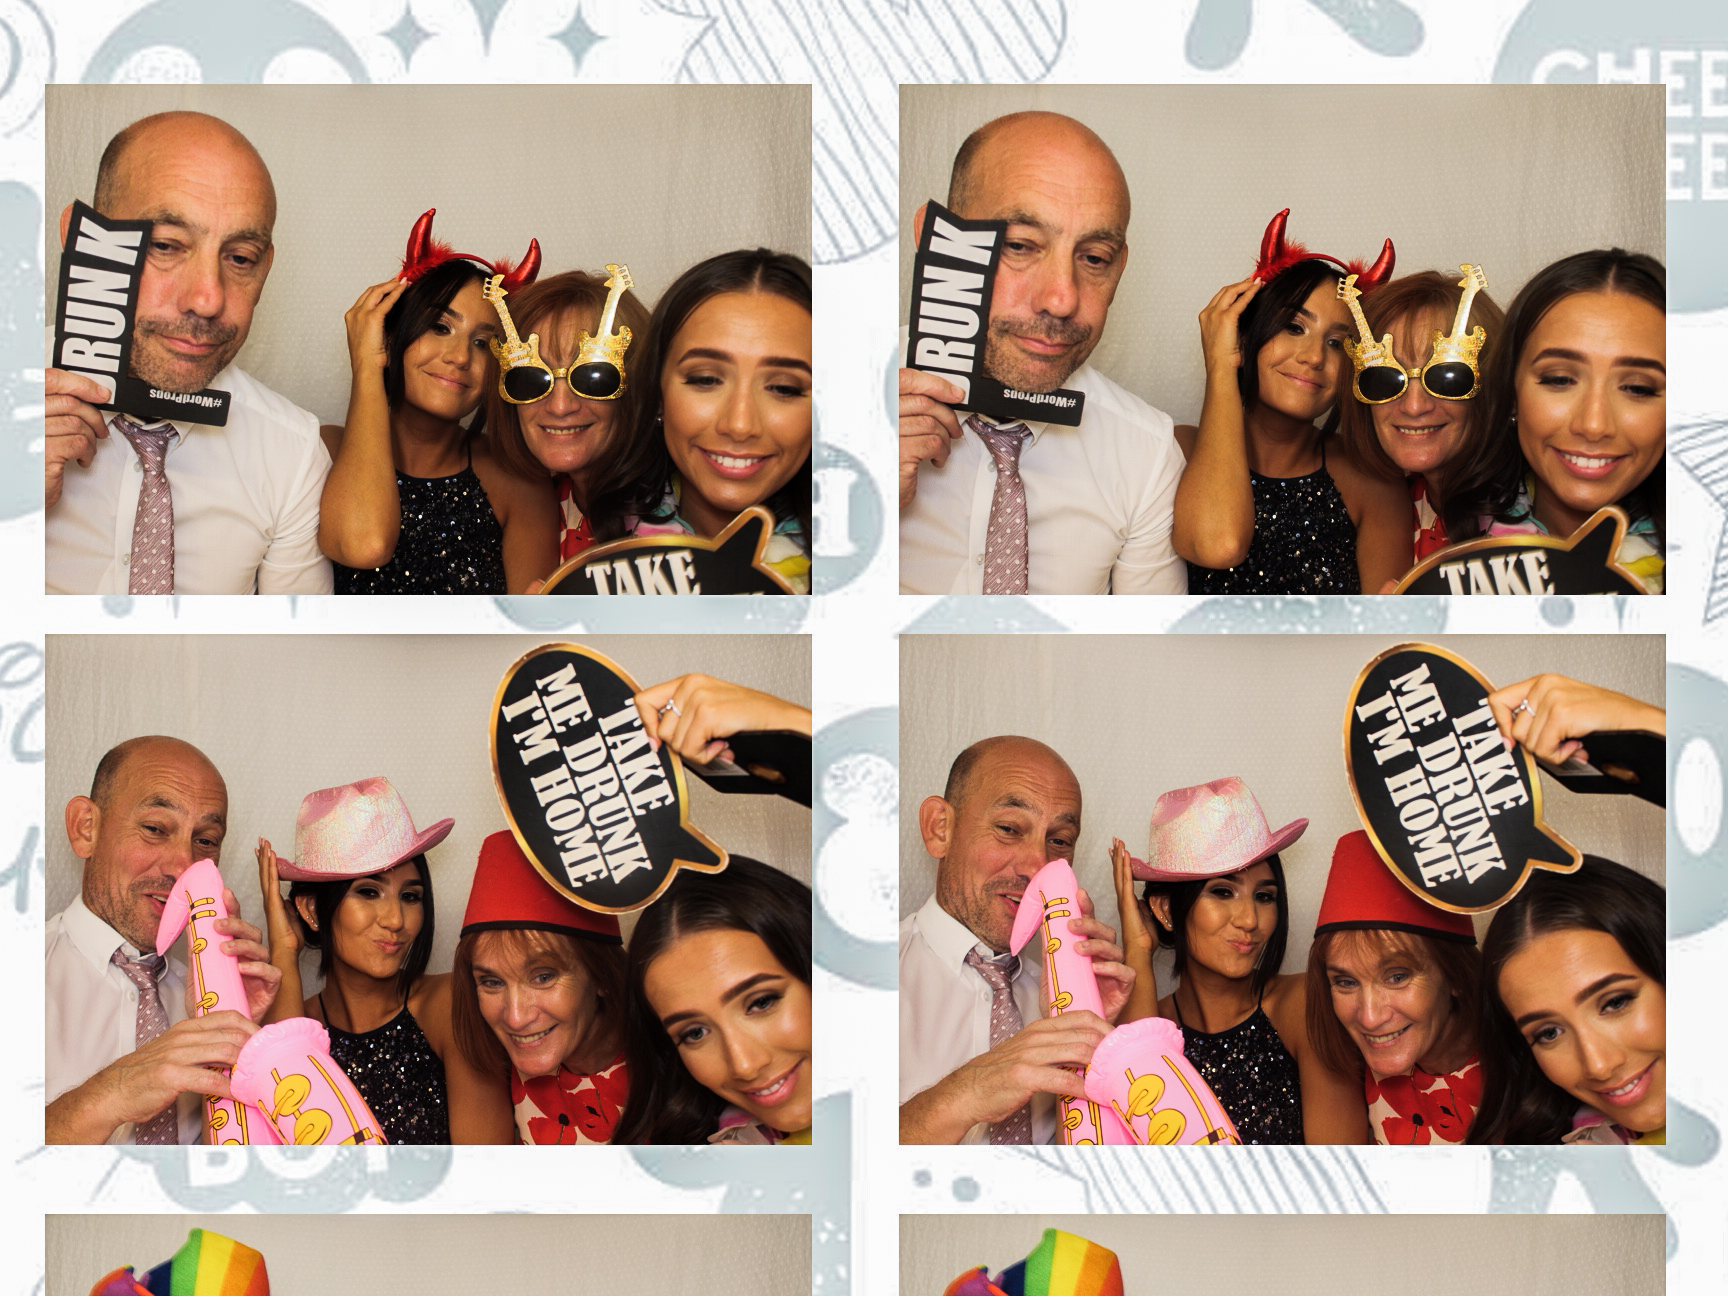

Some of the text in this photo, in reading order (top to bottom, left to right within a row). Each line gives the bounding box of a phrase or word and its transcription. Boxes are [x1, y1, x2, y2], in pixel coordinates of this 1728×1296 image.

[585, 549, 701, 595] TAKE
[1439, 549, 1555, 595] TAKE
[501, 690, 610, 888] I'M HOME
[535, 662, 653, 885] ME DRUNK
[597, 697, 676, 816] TAKE
[1355, 690, 1464, 888] I'M HOME
[1389, 662, 1507, 885] ME DRUNK
[1451, 697, 1530, 816] TAKE
